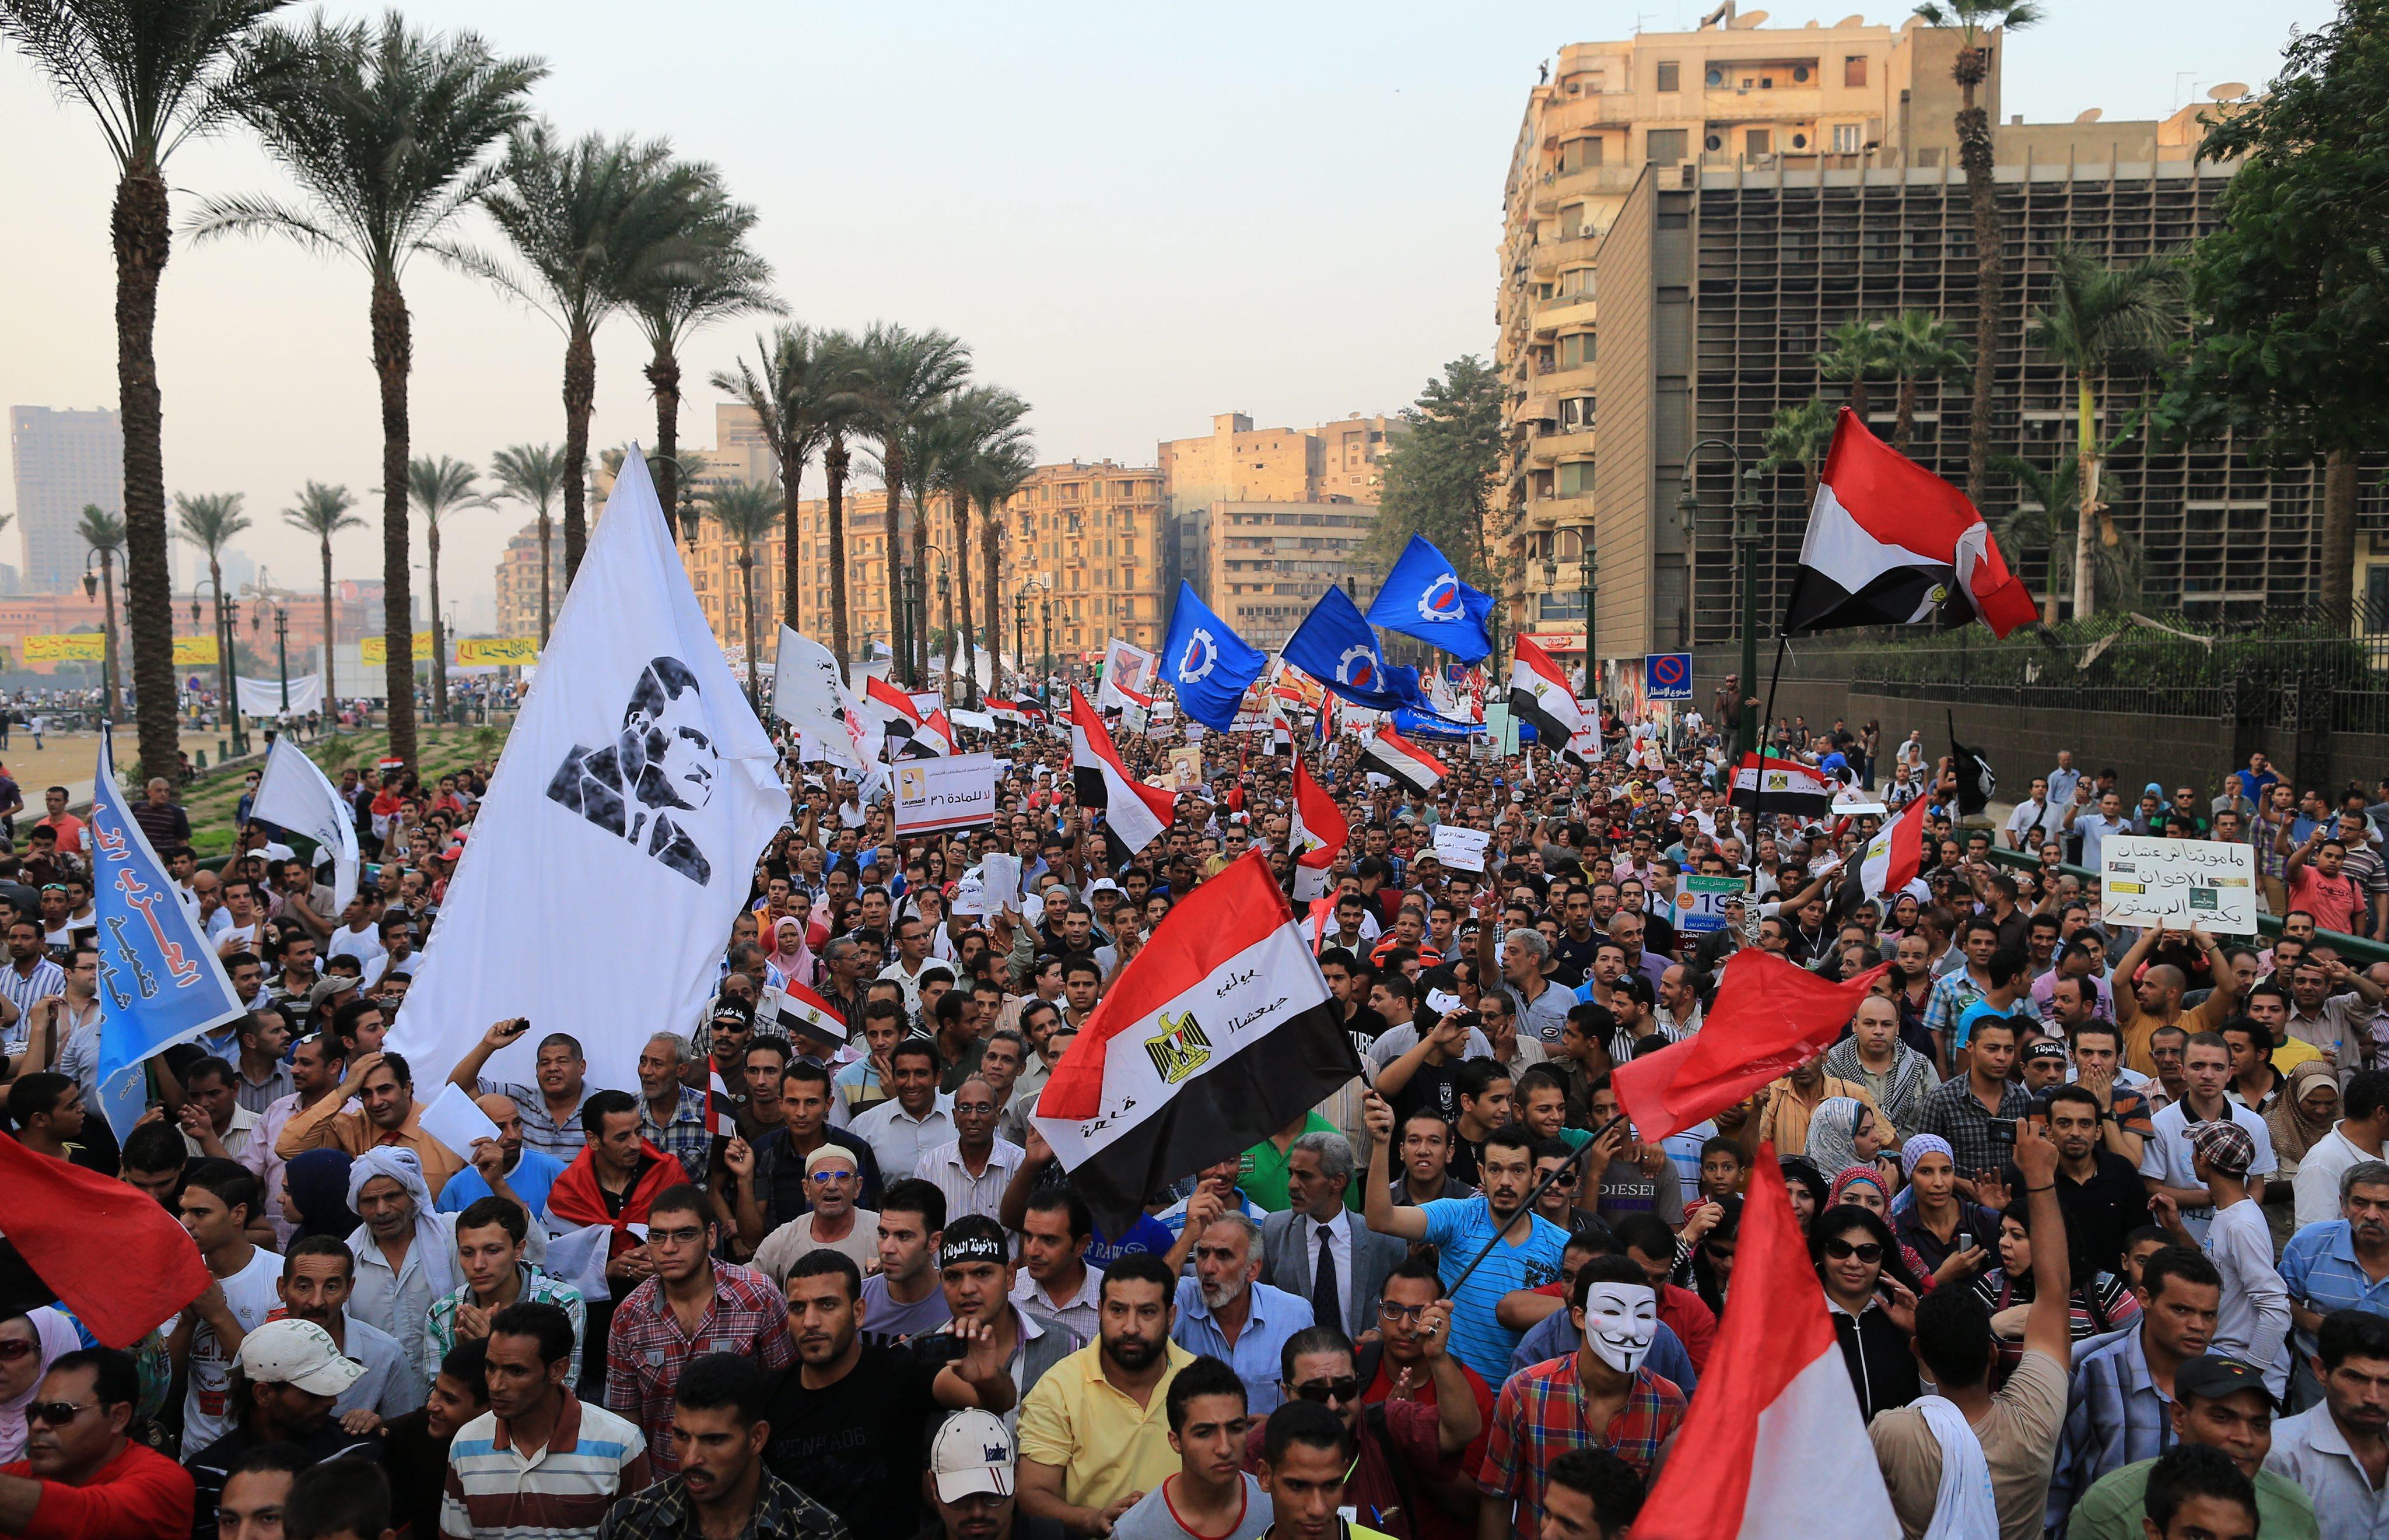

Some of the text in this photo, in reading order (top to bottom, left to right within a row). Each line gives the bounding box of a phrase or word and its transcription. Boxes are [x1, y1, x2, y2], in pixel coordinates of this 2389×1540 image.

[1648, 686, 1691, 698] ممنوع الانتظار
[902, 798, 926, 806] المصرى
[931, 790, 990, 805] لا للمادة ٣٦
[2117, 842, 2161, 858] عشان
[1690, 877, 1707, 885] عزبة
[1708, 879, 1726, 887] مش
[2106, 899, 2187, 917] الدستور
[114, 867, 202, 988] الحزب
[105, 915, 159, 999] تنمية
[724, 1007, 735, 1017] حكم
[2040, 1044, 2055, 1054] الدولة
[1598, 1183, 1656, 1196] DIESEL
[947, 1240, 969, 1259] الدولة
[969, 1237, 993, 1256] لأخونة
[993, 1241, 999, 1255] لا
[1095, 1242, 1123, 1260] RAW
